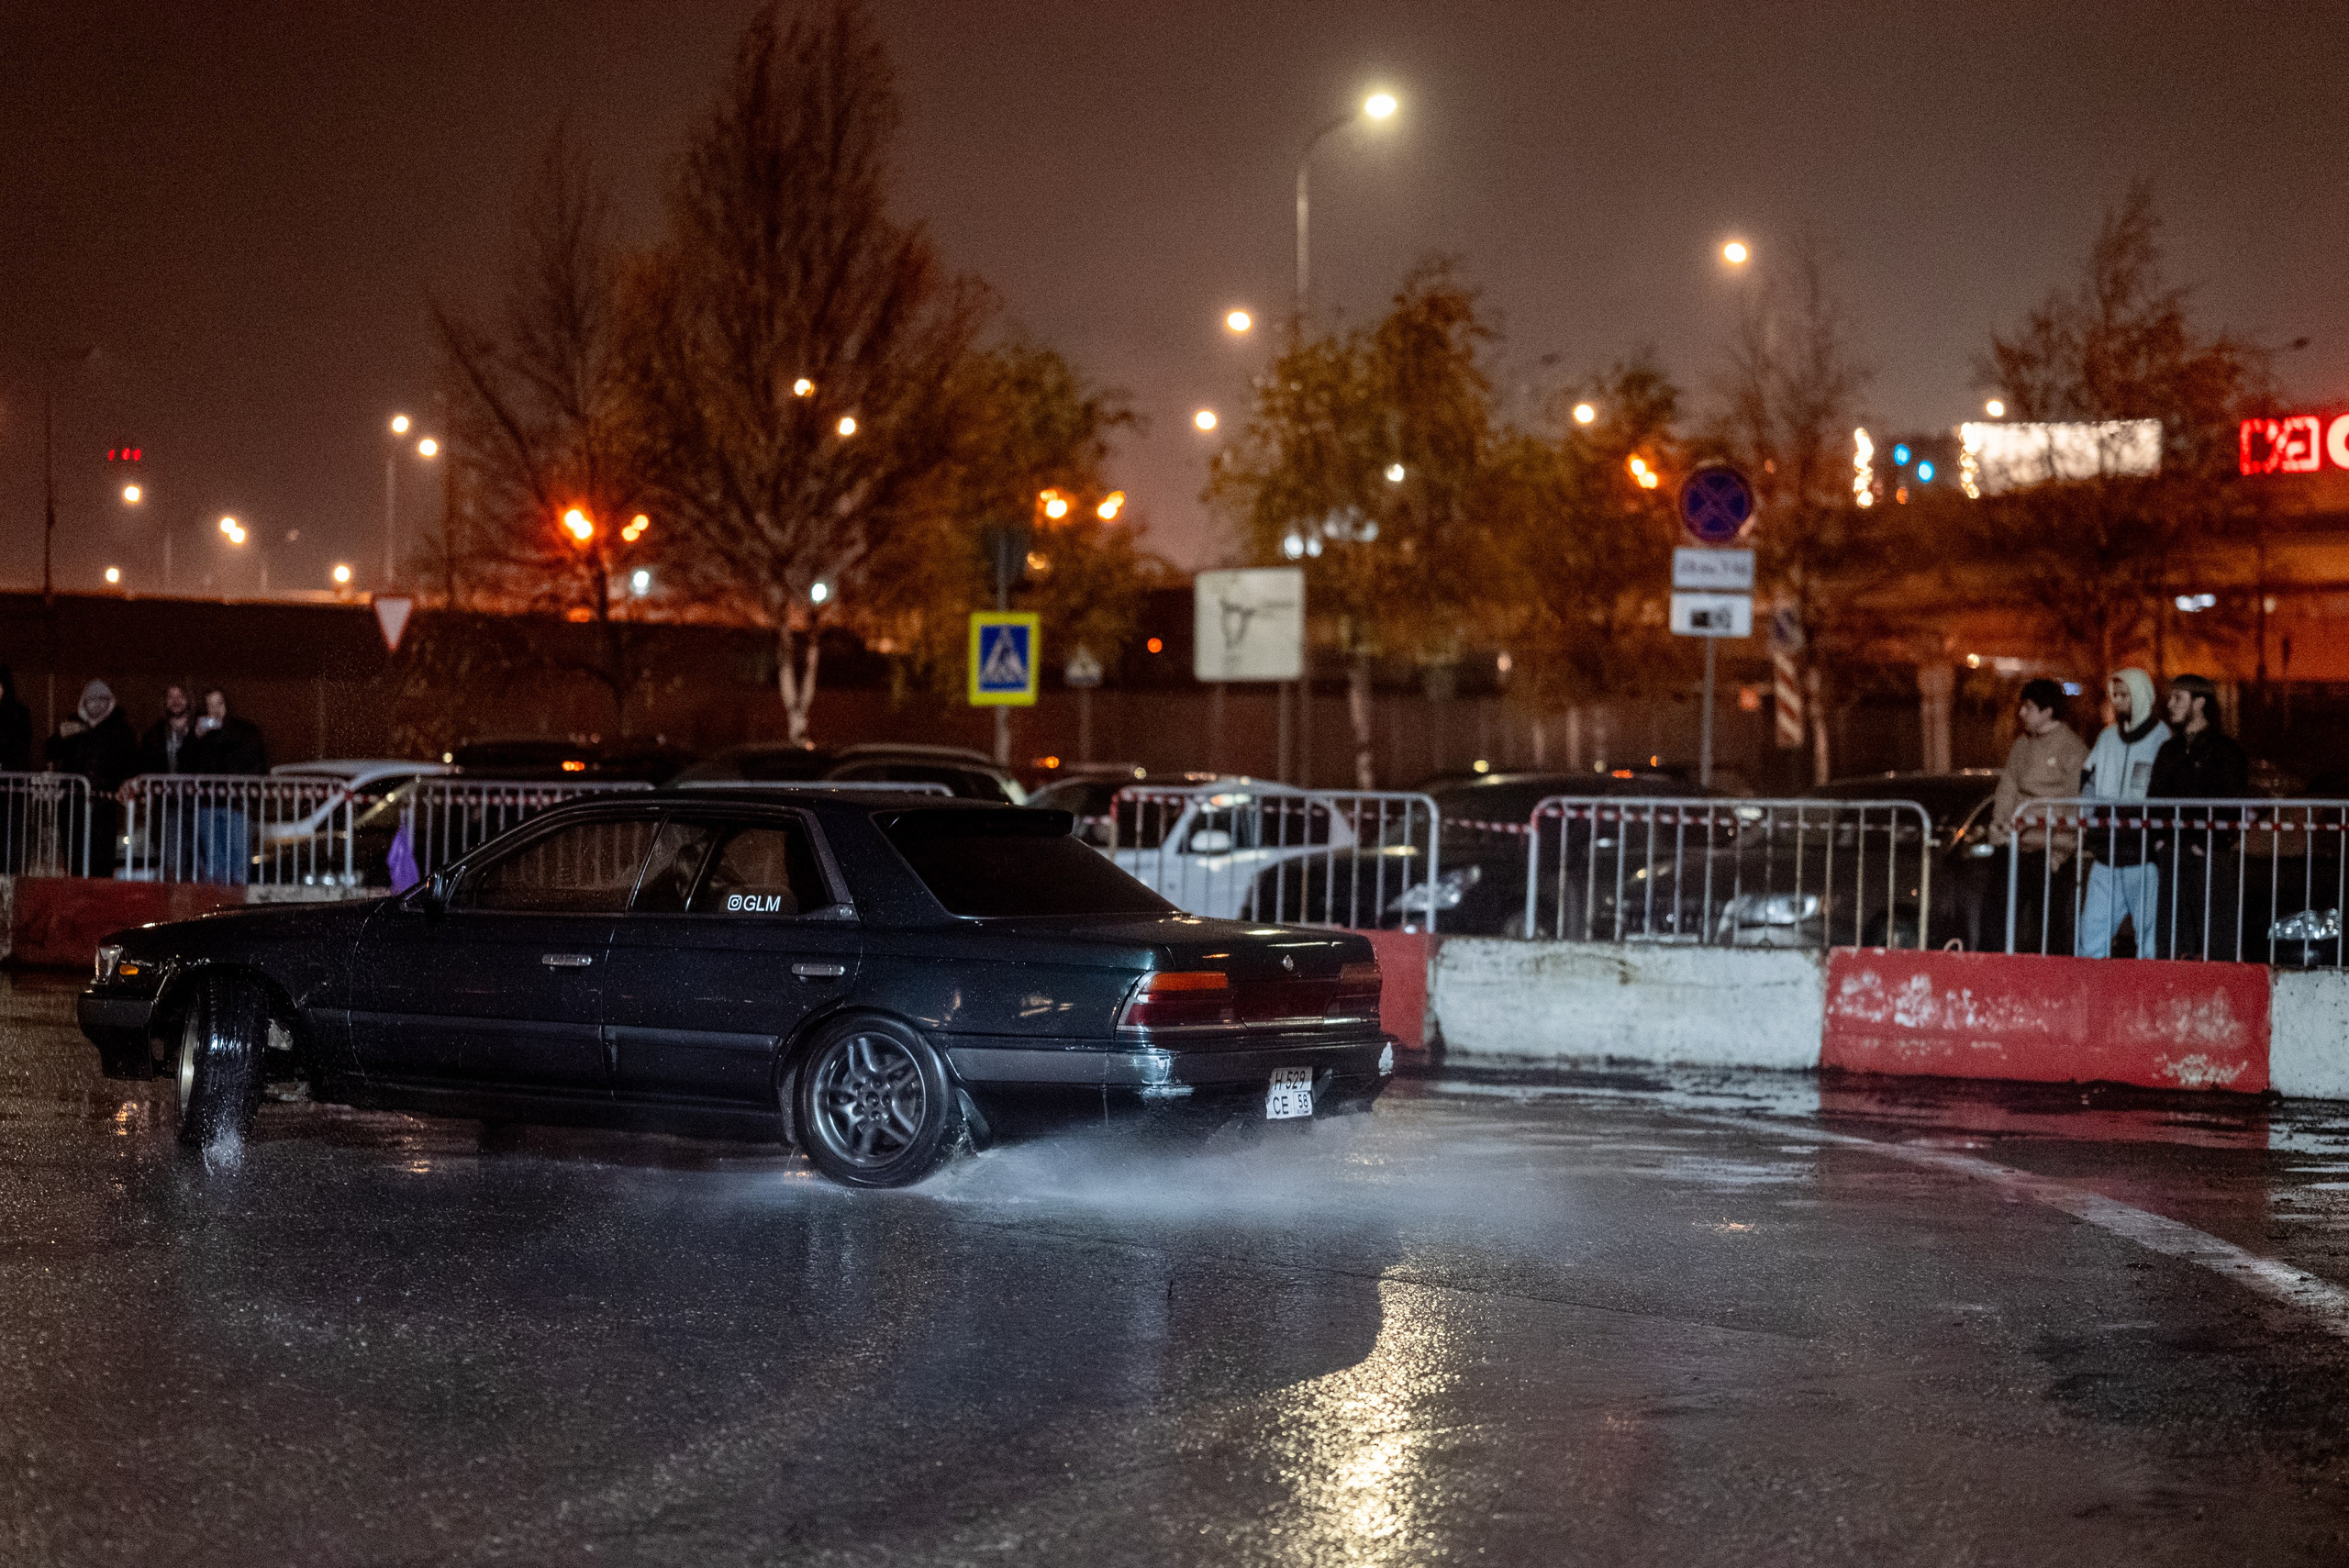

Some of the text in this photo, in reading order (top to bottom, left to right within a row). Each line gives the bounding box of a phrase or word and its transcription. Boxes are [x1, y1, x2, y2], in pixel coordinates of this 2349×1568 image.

[743, 895, 781, 911] GLM
[1286, 1070, 1305, 1089] 529
[1297, 1094, 1308, 1108] 58
